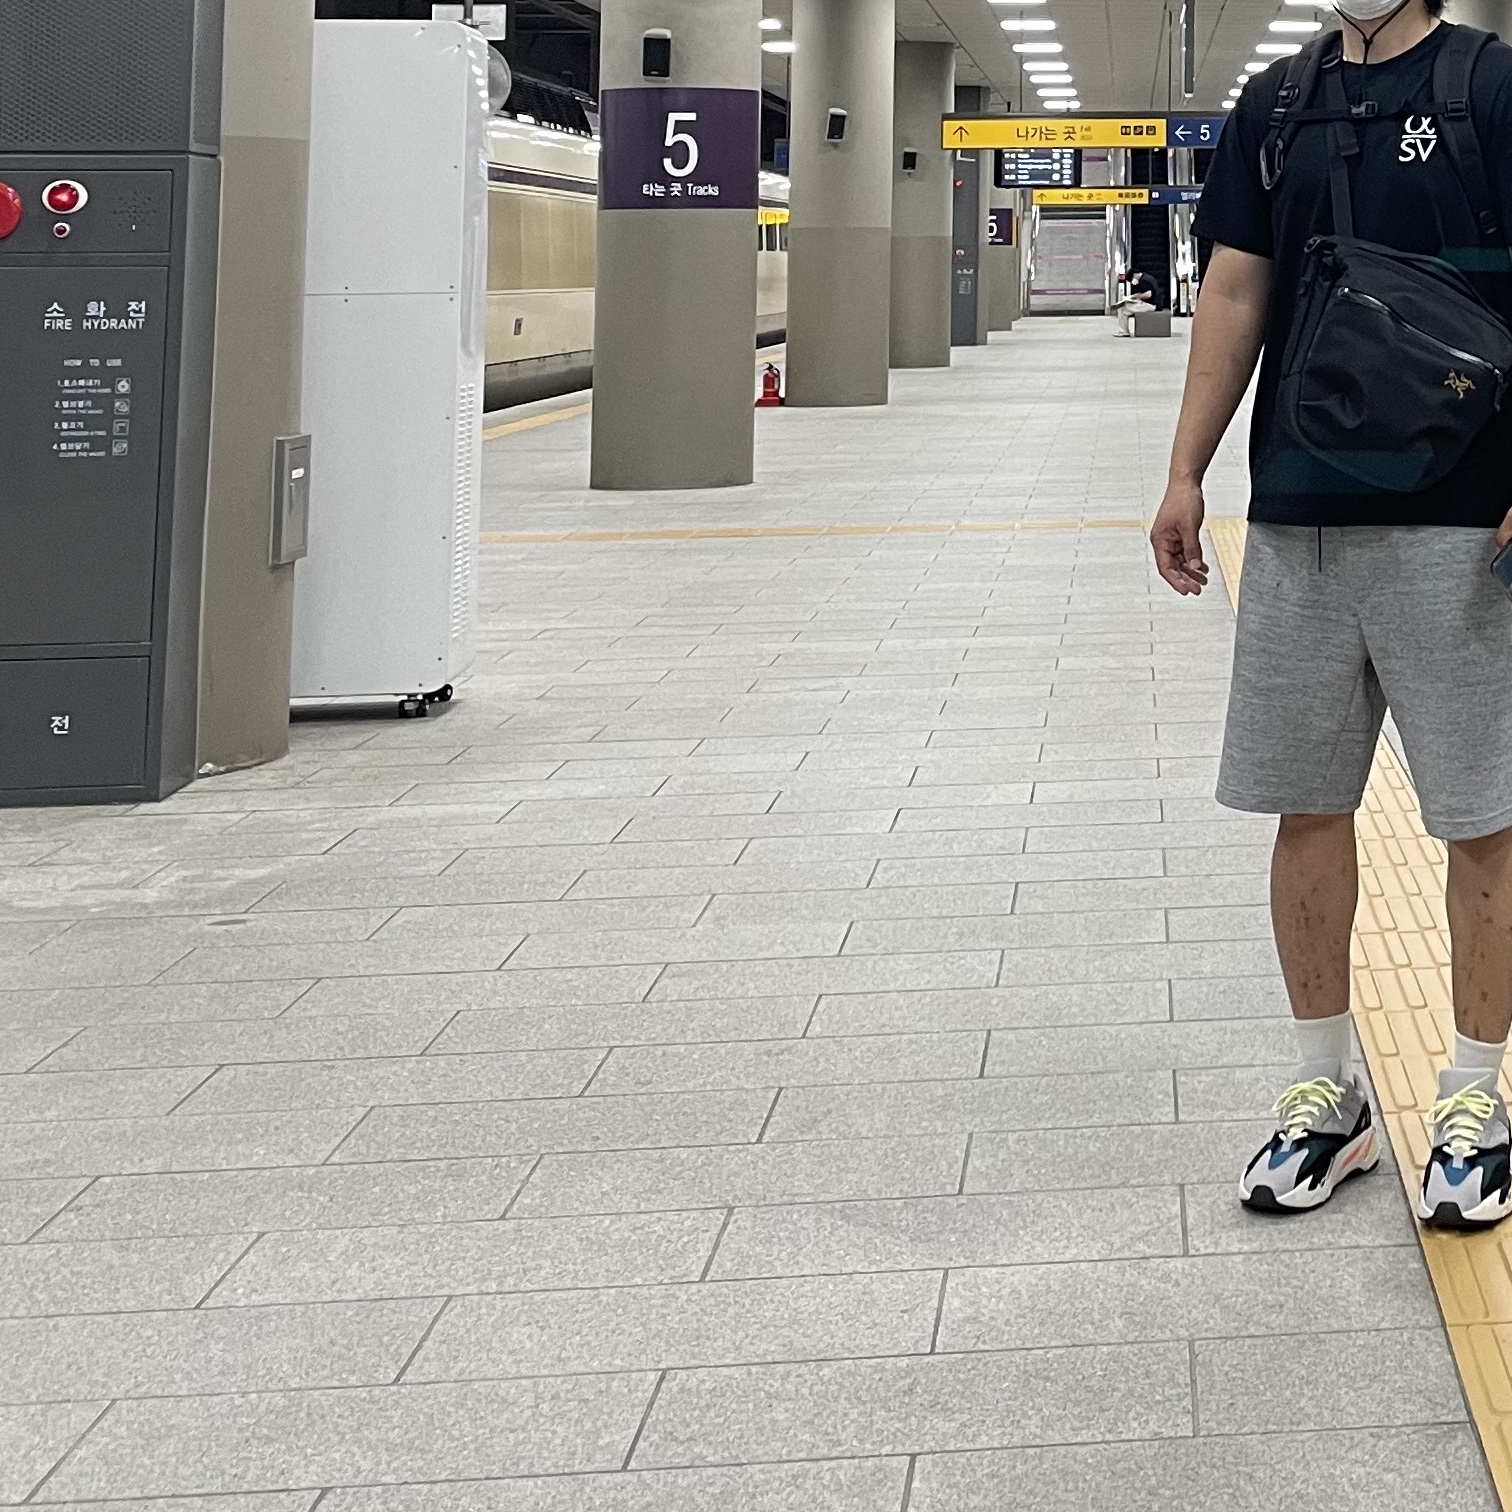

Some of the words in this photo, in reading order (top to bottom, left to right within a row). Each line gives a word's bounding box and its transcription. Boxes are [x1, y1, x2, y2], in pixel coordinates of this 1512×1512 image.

[1016, 125, 1058, 142] 나가는
[1063, 125, 1077, 142] 곳
[1199, 124, 1211, 141] 5
[663, 112, 699, 177] 5
[1398, 138, 1437, 162] SV
[642, 182, 666, 197] 타는
[669, 182, 683, 197] 곳
[686, 182, 720, 196] Tracks
[43, 318, 73, 331] FIRE
[82, 317, 146, 331] HYDRANT
[50, 714, 70, 735] 전
